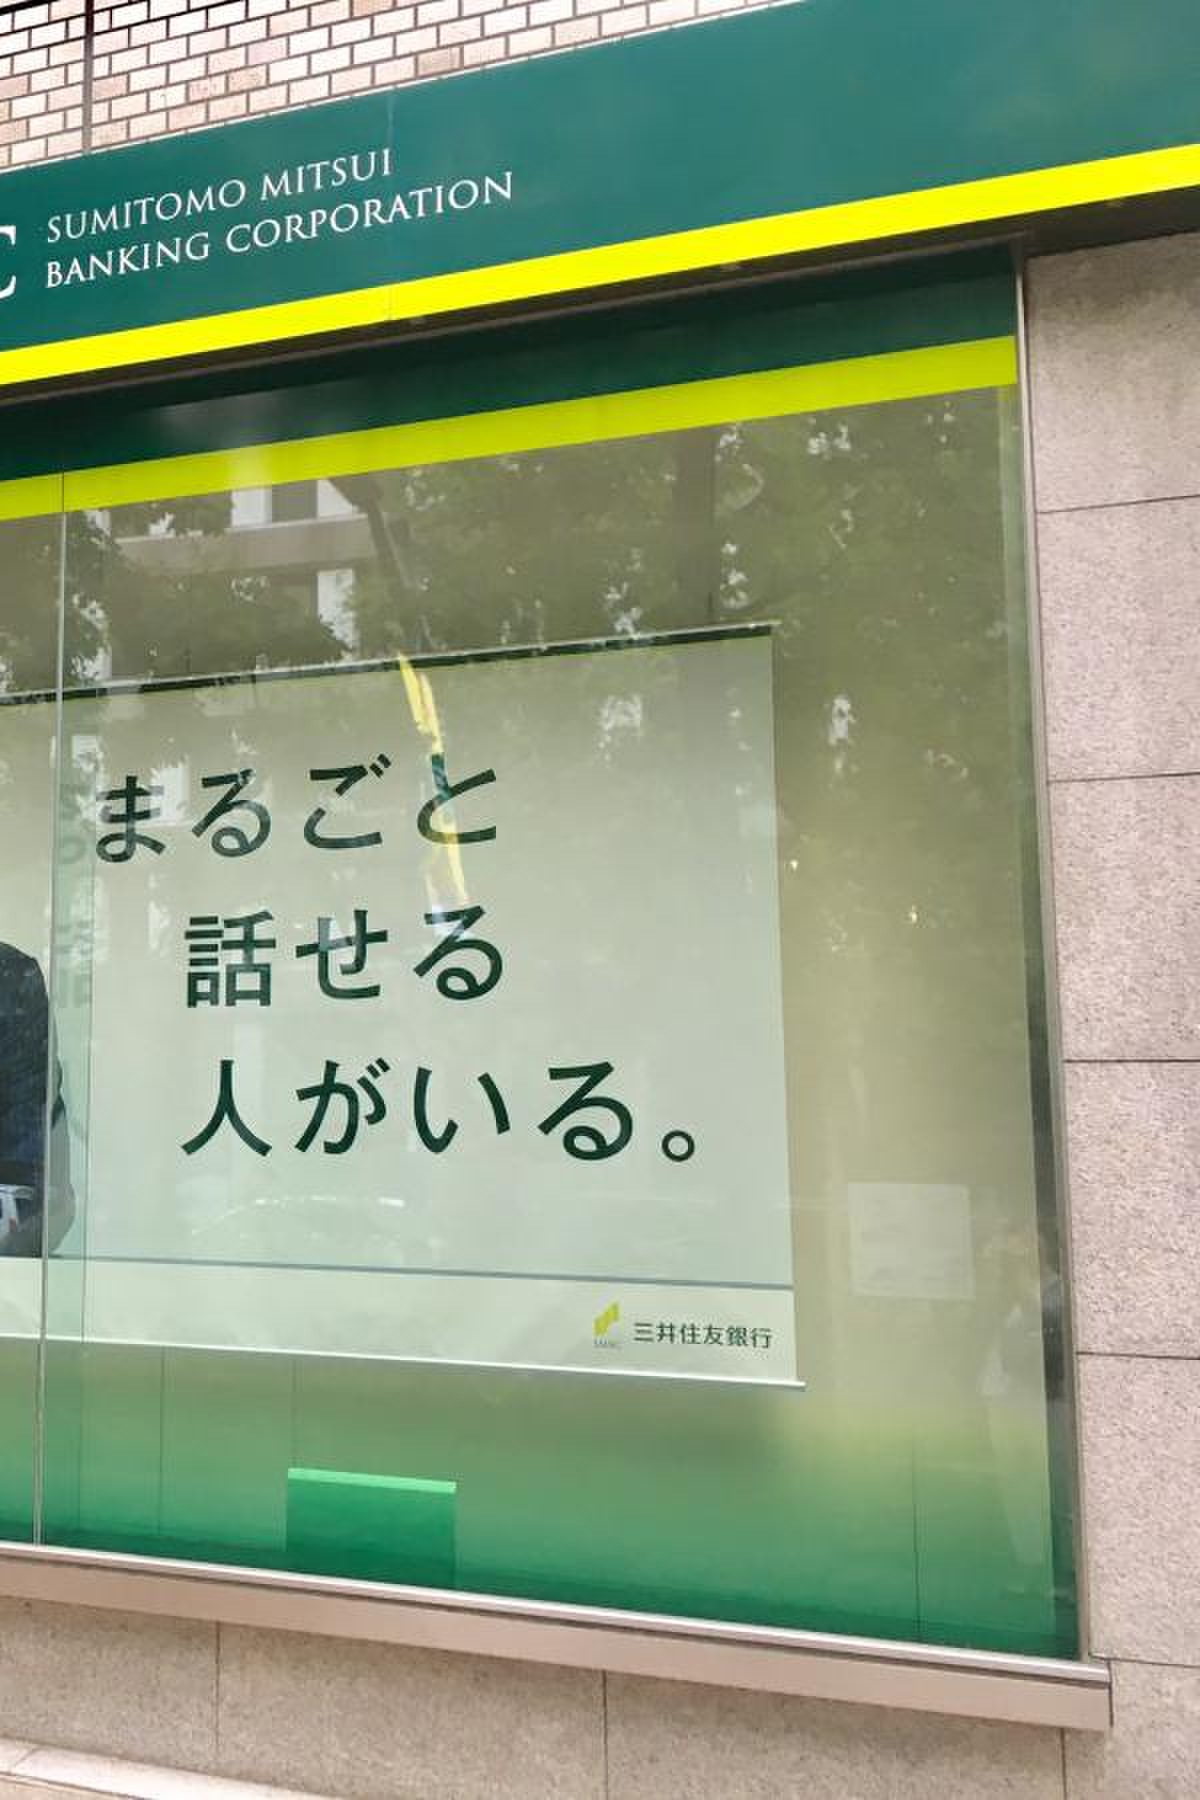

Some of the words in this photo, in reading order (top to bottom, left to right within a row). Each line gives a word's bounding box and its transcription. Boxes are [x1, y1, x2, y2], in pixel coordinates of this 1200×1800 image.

[46, 231, 210, 289] BANKING
[225, 171, 513, 253] CORPORATION
[47, 179, 246, 243] SUMITOMO
[260, 148, 393, 201] MITSUI
[95, 754, 497, 863] まるごと
[184, 905, 503, 1008] 話せる
[181, 1057, 696, 1163] 人がいる。
[633, 1321, 773, 1350] 三井住友銀行
